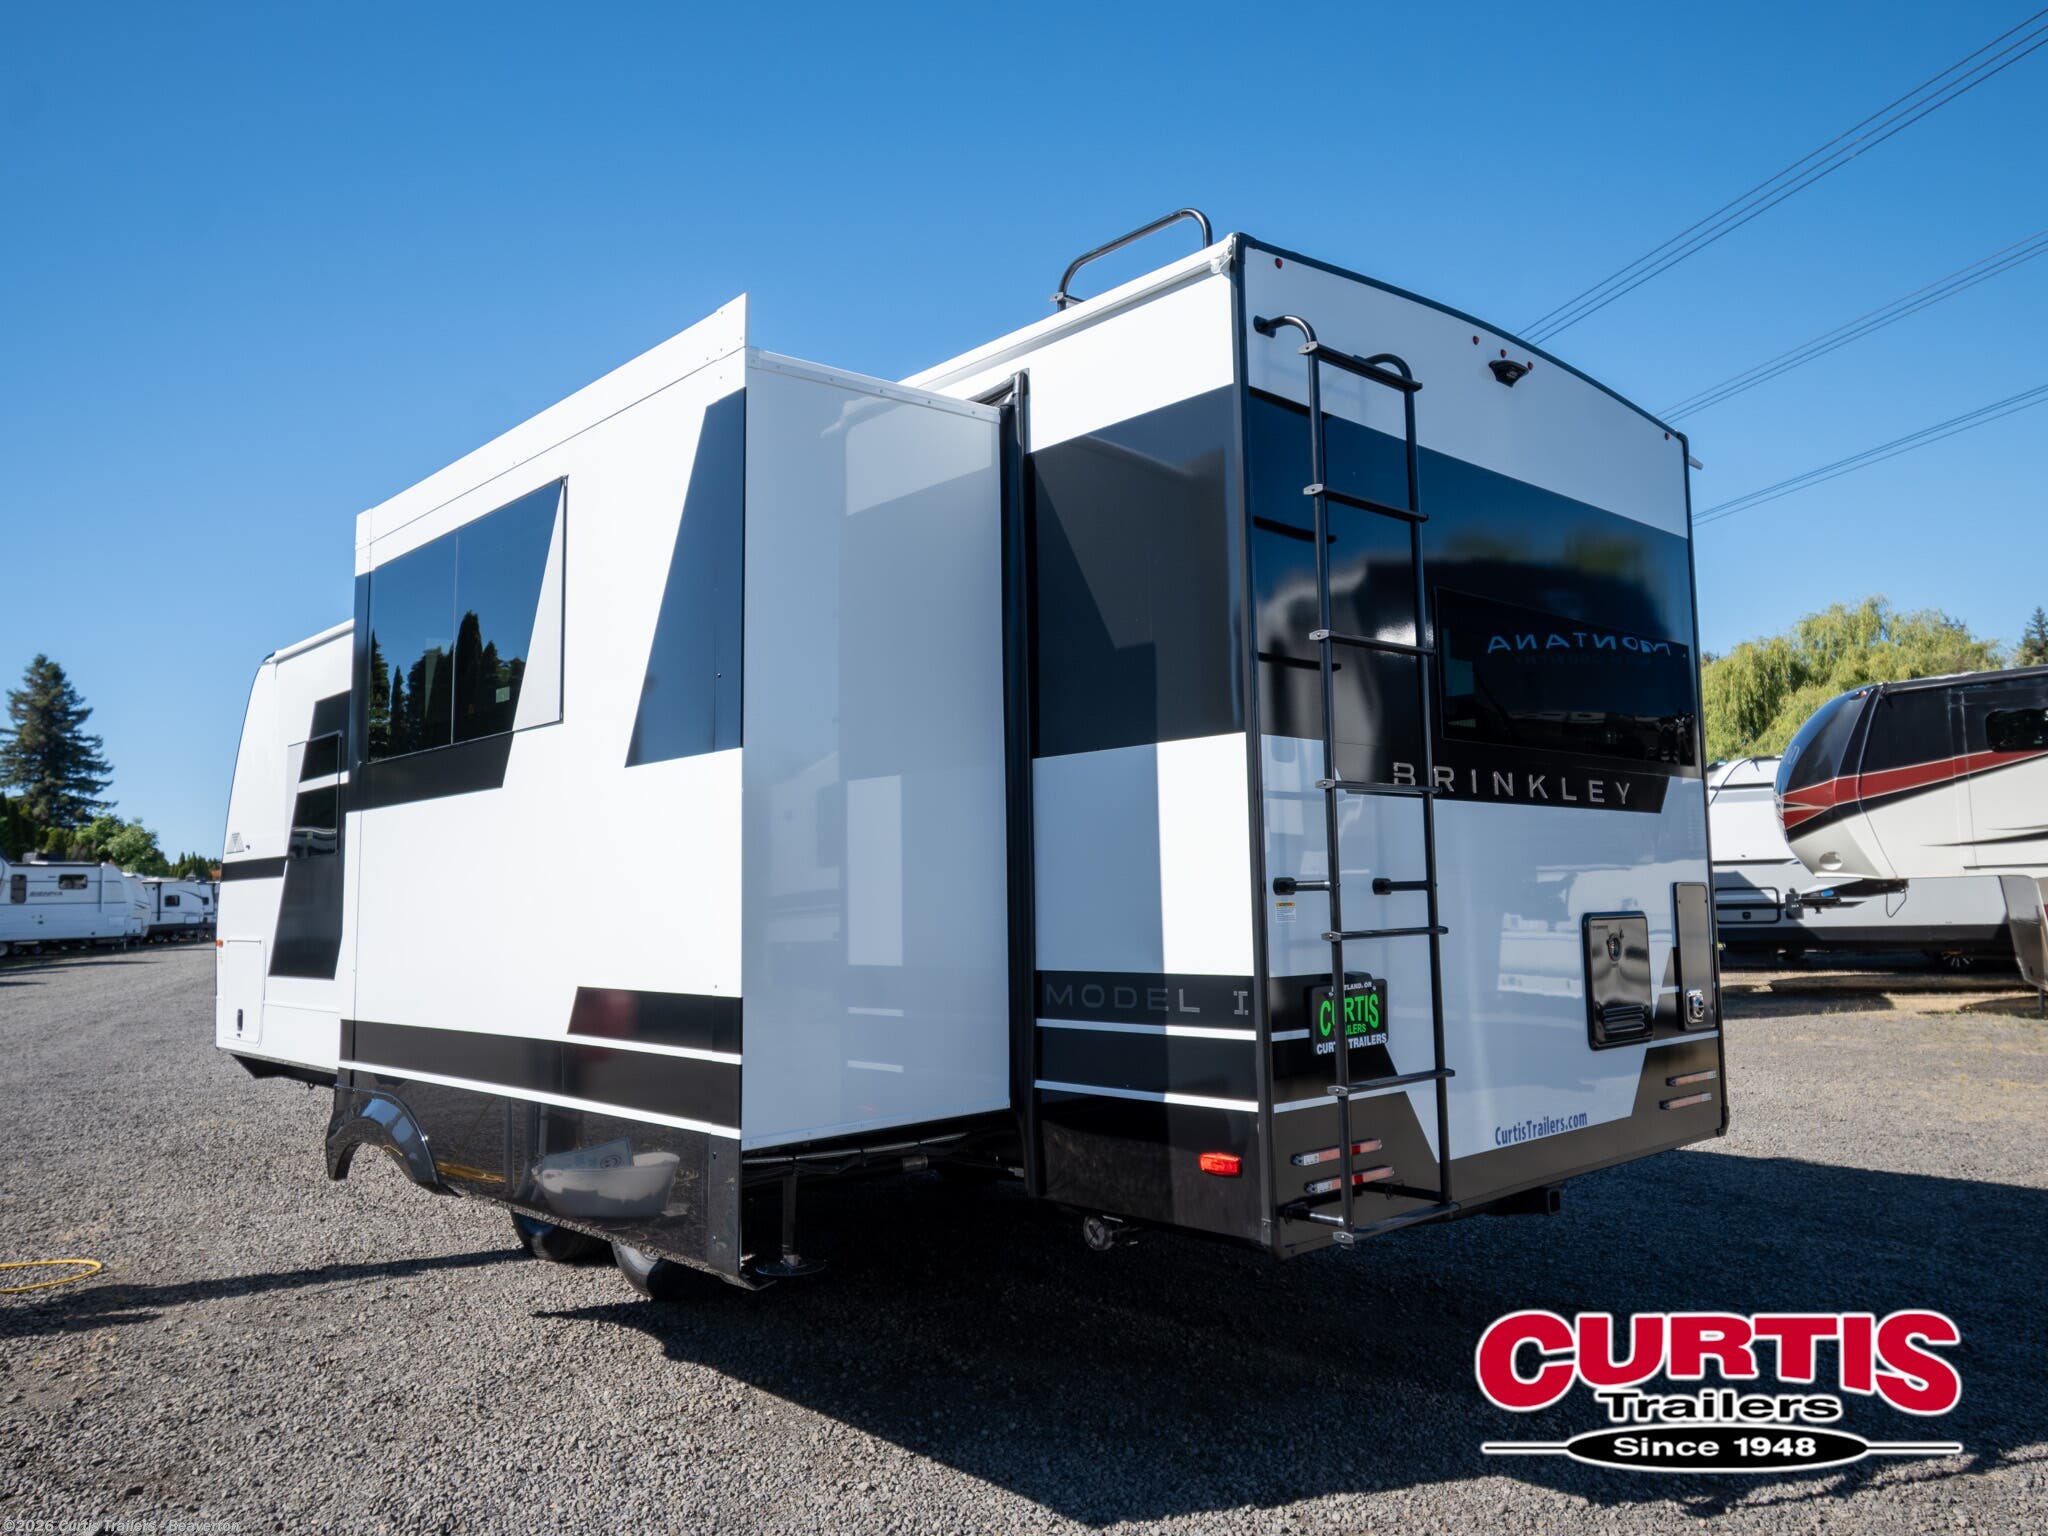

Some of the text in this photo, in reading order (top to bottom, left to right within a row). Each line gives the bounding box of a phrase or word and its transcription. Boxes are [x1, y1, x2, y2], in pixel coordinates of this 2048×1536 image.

[1393, 761, 1632, 805] BRINKLEY
[1046, 983, 1200, 1014] MODEL
[1348, 1033, 1387, 1049] TRAILERS
[1495, 1112, 1588, 1146] CurtisTrailers.com
